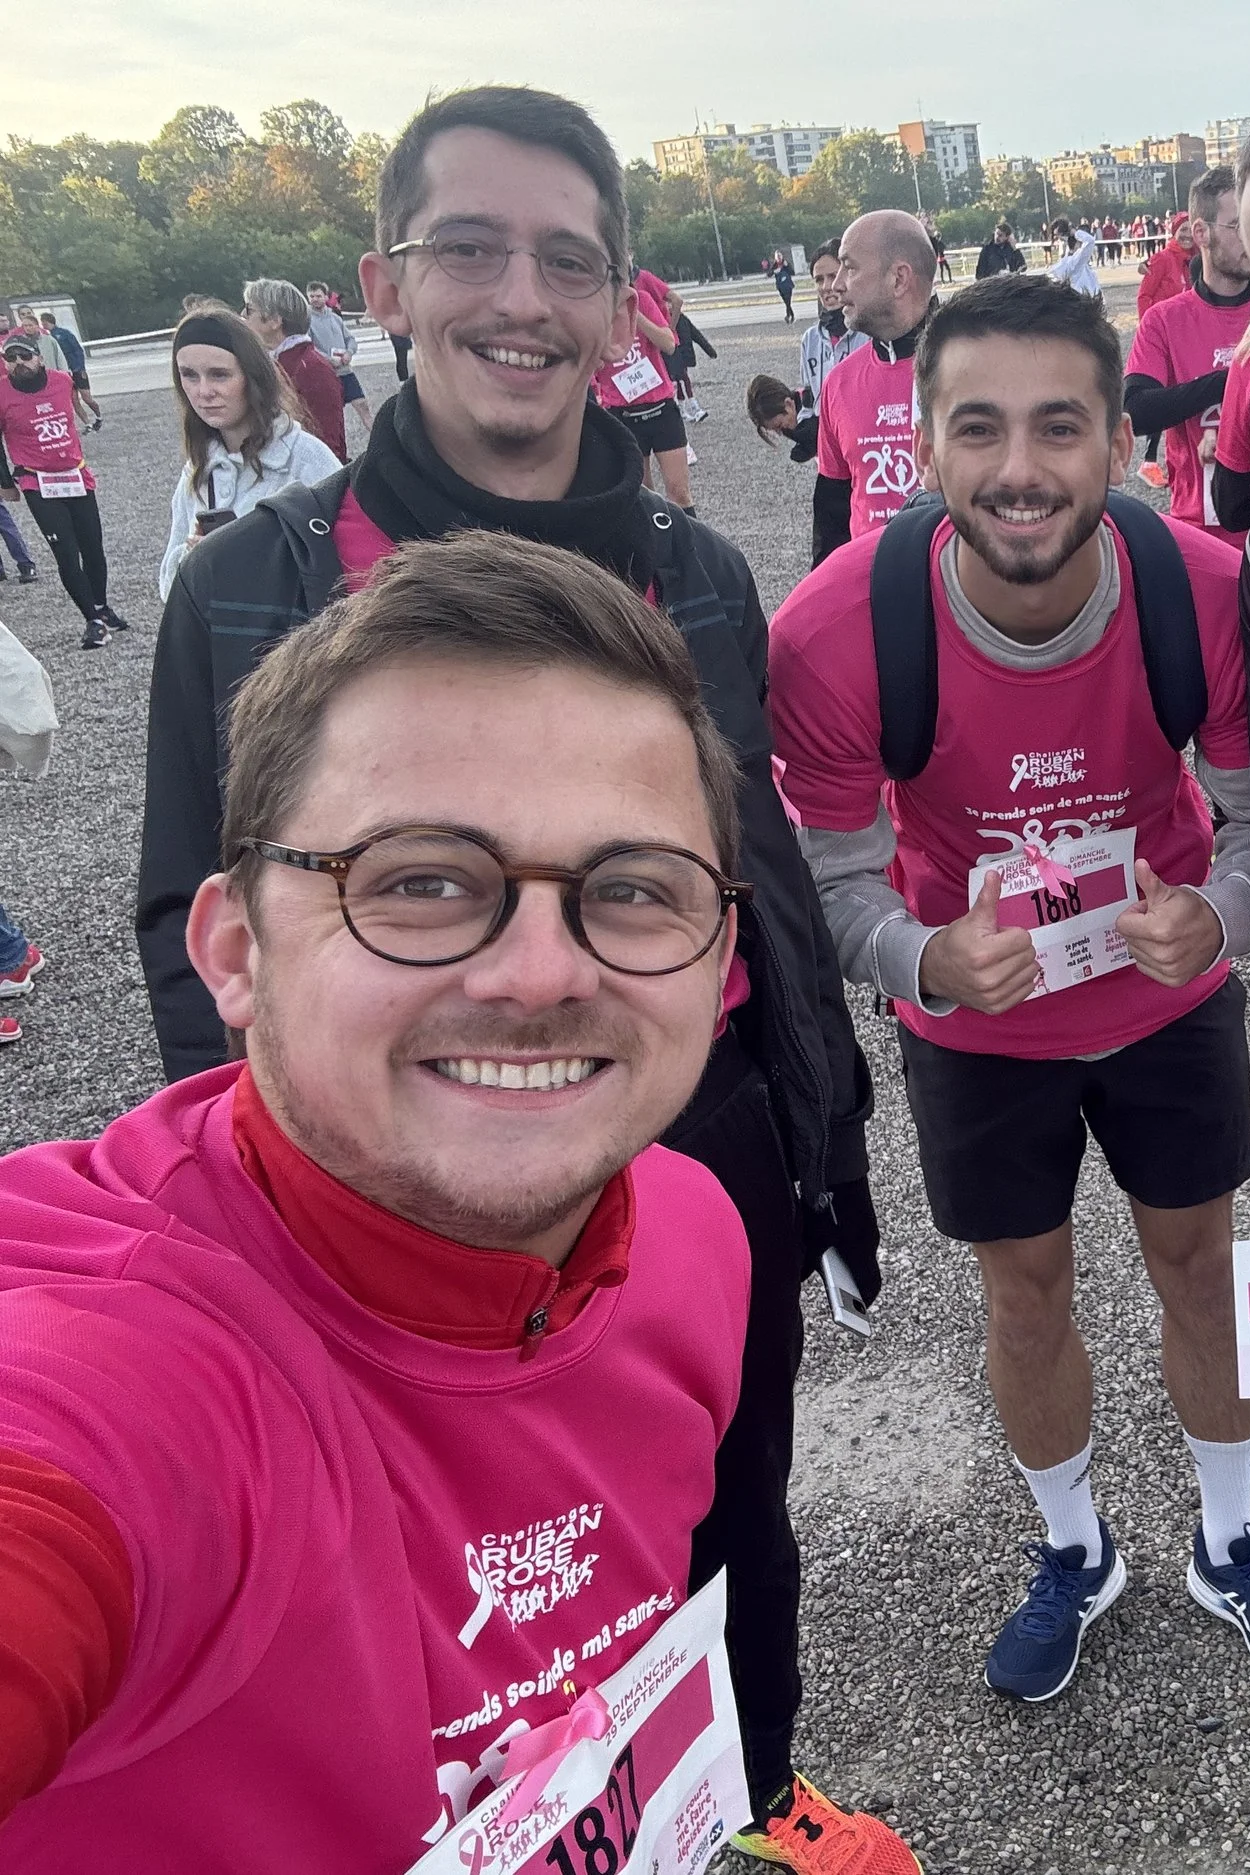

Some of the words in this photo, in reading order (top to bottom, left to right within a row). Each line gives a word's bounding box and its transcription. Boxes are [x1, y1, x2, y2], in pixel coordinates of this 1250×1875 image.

[1030, 751, 1085, 767] RUBAN
[1031, 761, 1073, 776] ROSE
[982, 806, 1027, 821] prends
[1029, 803, 1055, 816] soin
[1057, 796, 1073, 809] de
[1075, 793, 1093, 805] ma
[1095, 787, 1132, 802] santé
[1087, 805, 1126, 823] ANS
[1006, 867, 1032, 880] ROSE
[1069, 848, 1106, 864] DIMANCHE
[1072, 853, 1112, 869] SEPTEMBRE
[481, 1503, 589, 1547] Challenge
[482, 1510, 602, 1573] RUBAN
[486, 1540, 575, 1591] ROSE
[431, 1690, 503, 1740] rends
[552, 1647, 576, 1683] de
[581, 1625, 613, 1661] ma
[614, 1586, 677, 1639] santé
[612, 1646, 676, 1720] DIMANCHE
[605, 1724, 618, 1748] 29
[619, 1649, 688, 1727] SEPTEMBRE
[545, 1742, 642, 1875] 1827
[674, 1812, 685, 1833] Je
[685, 1779, 710, 1814] cours
[676, 1824, 689, 1845] me
[689, 1792, 712, 1827] faire
